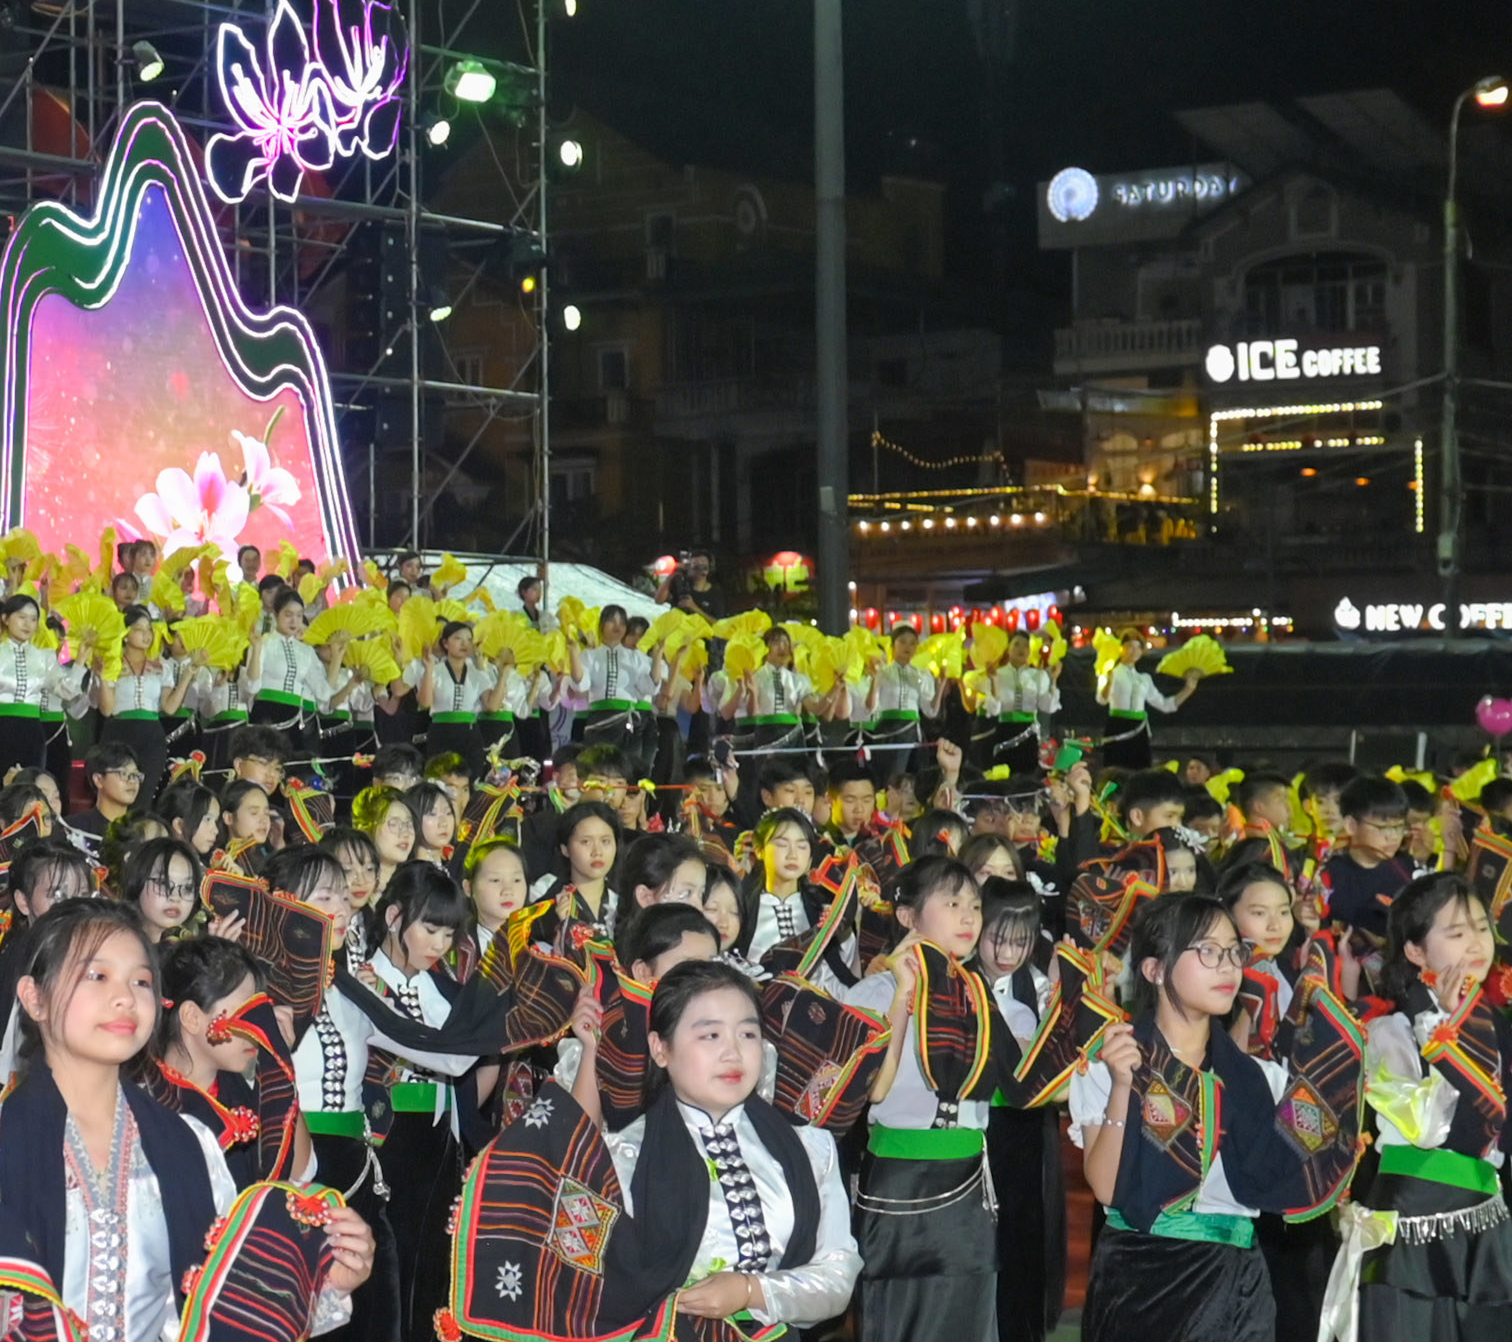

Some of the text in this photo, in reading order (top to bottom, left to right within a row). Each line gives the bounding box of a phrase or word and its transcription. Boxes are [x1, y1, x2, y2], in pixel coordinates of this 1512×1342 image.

[1237, 339, 1382, 381] ICE COFFEE
[1365, 603, 1424, 631] NEW
